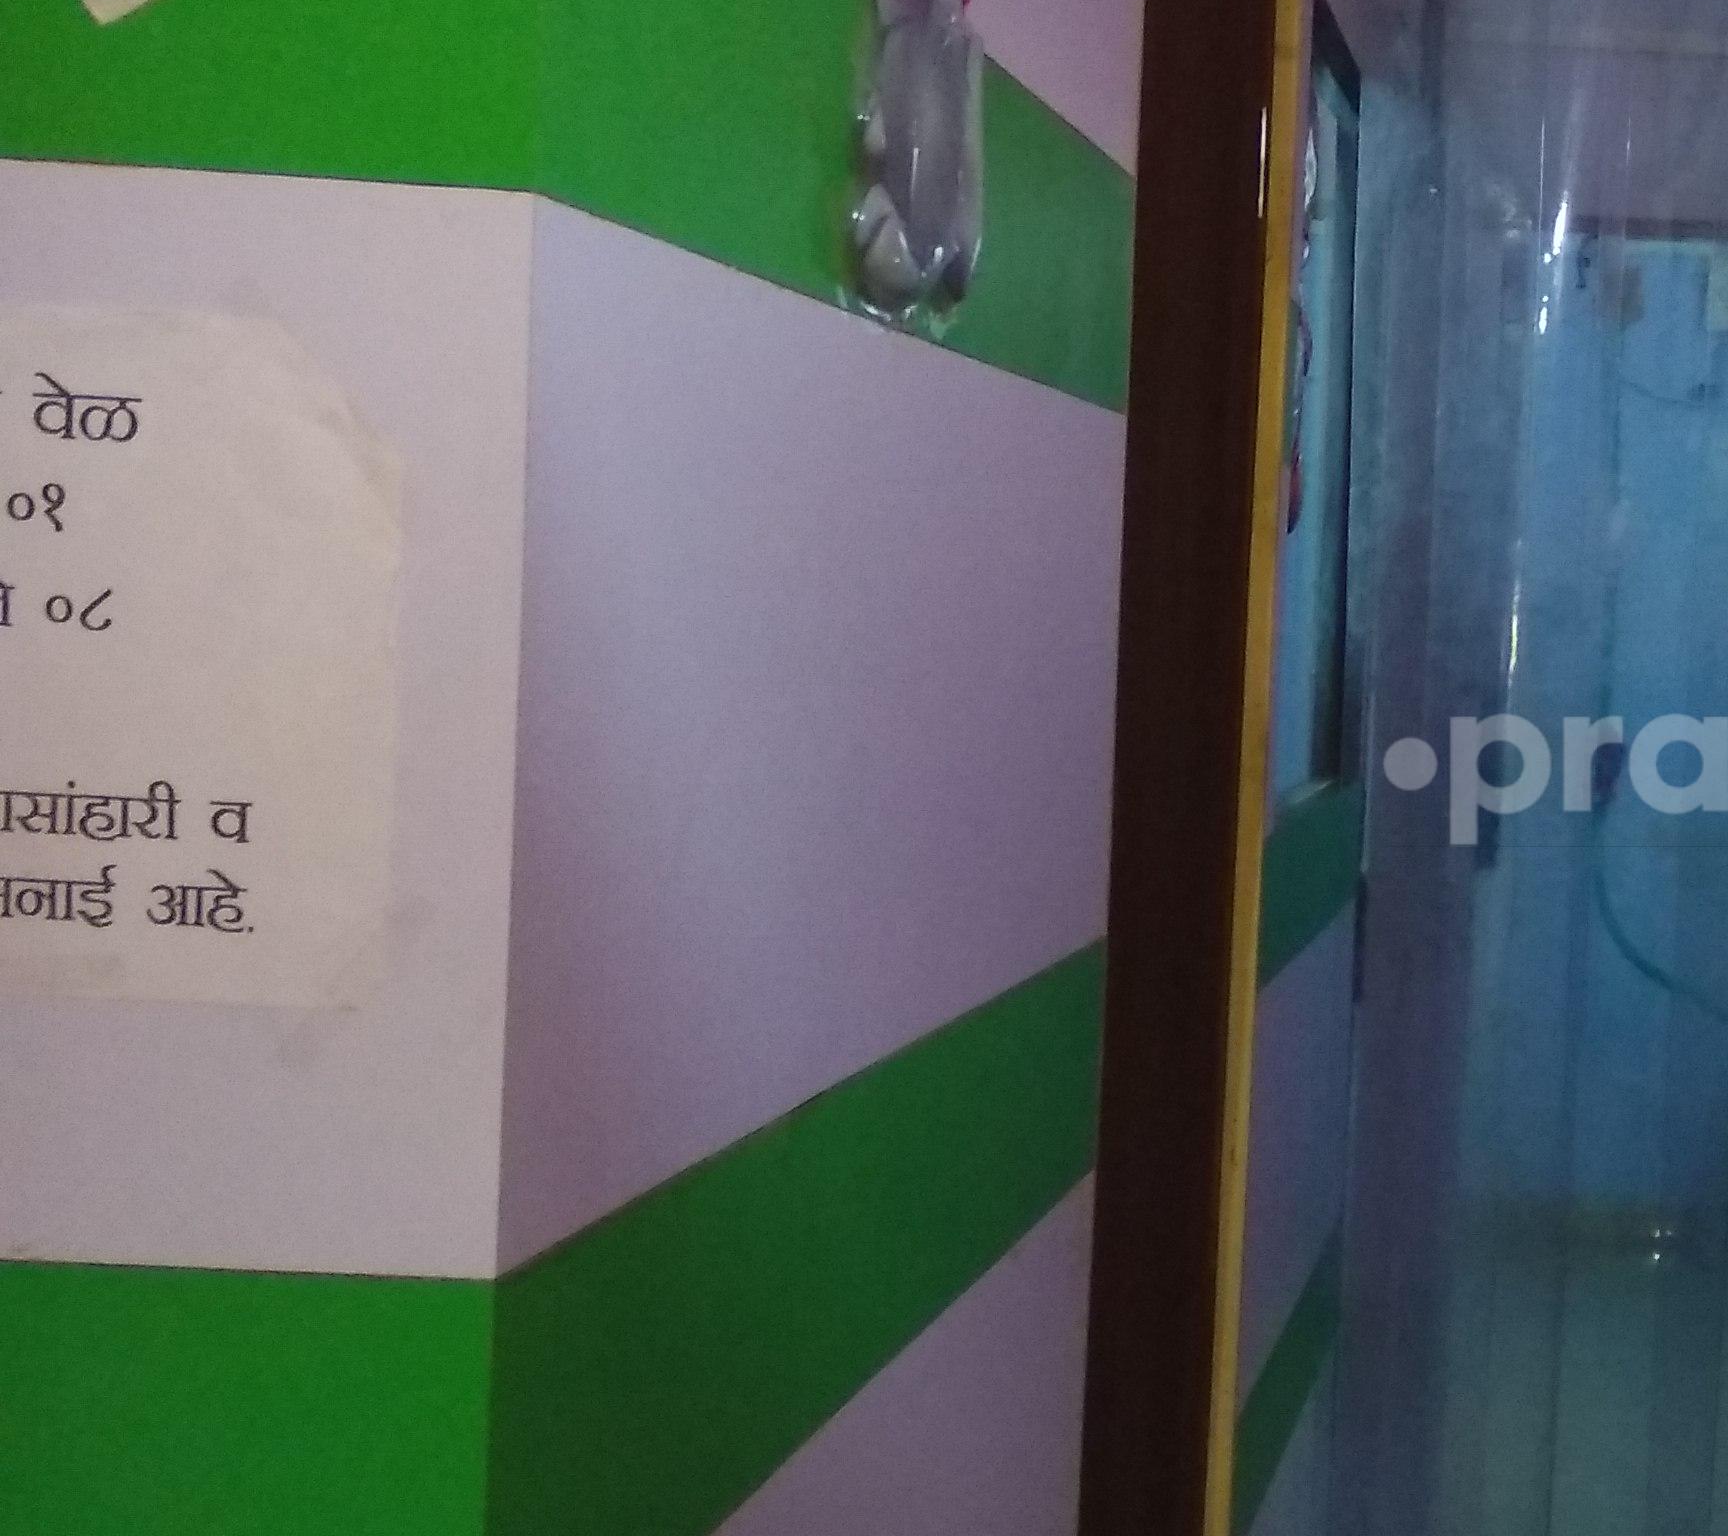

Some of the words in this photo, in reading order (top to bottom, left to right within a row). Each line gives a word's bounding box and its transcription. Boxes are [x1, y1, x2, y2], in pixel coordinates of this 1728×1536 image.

[33, 371, 142, 444] वेळ
[45, 588, 113, 632] ०८
[210, 800, 253, 844] व
[147, 869, 254, 934] आहे.
